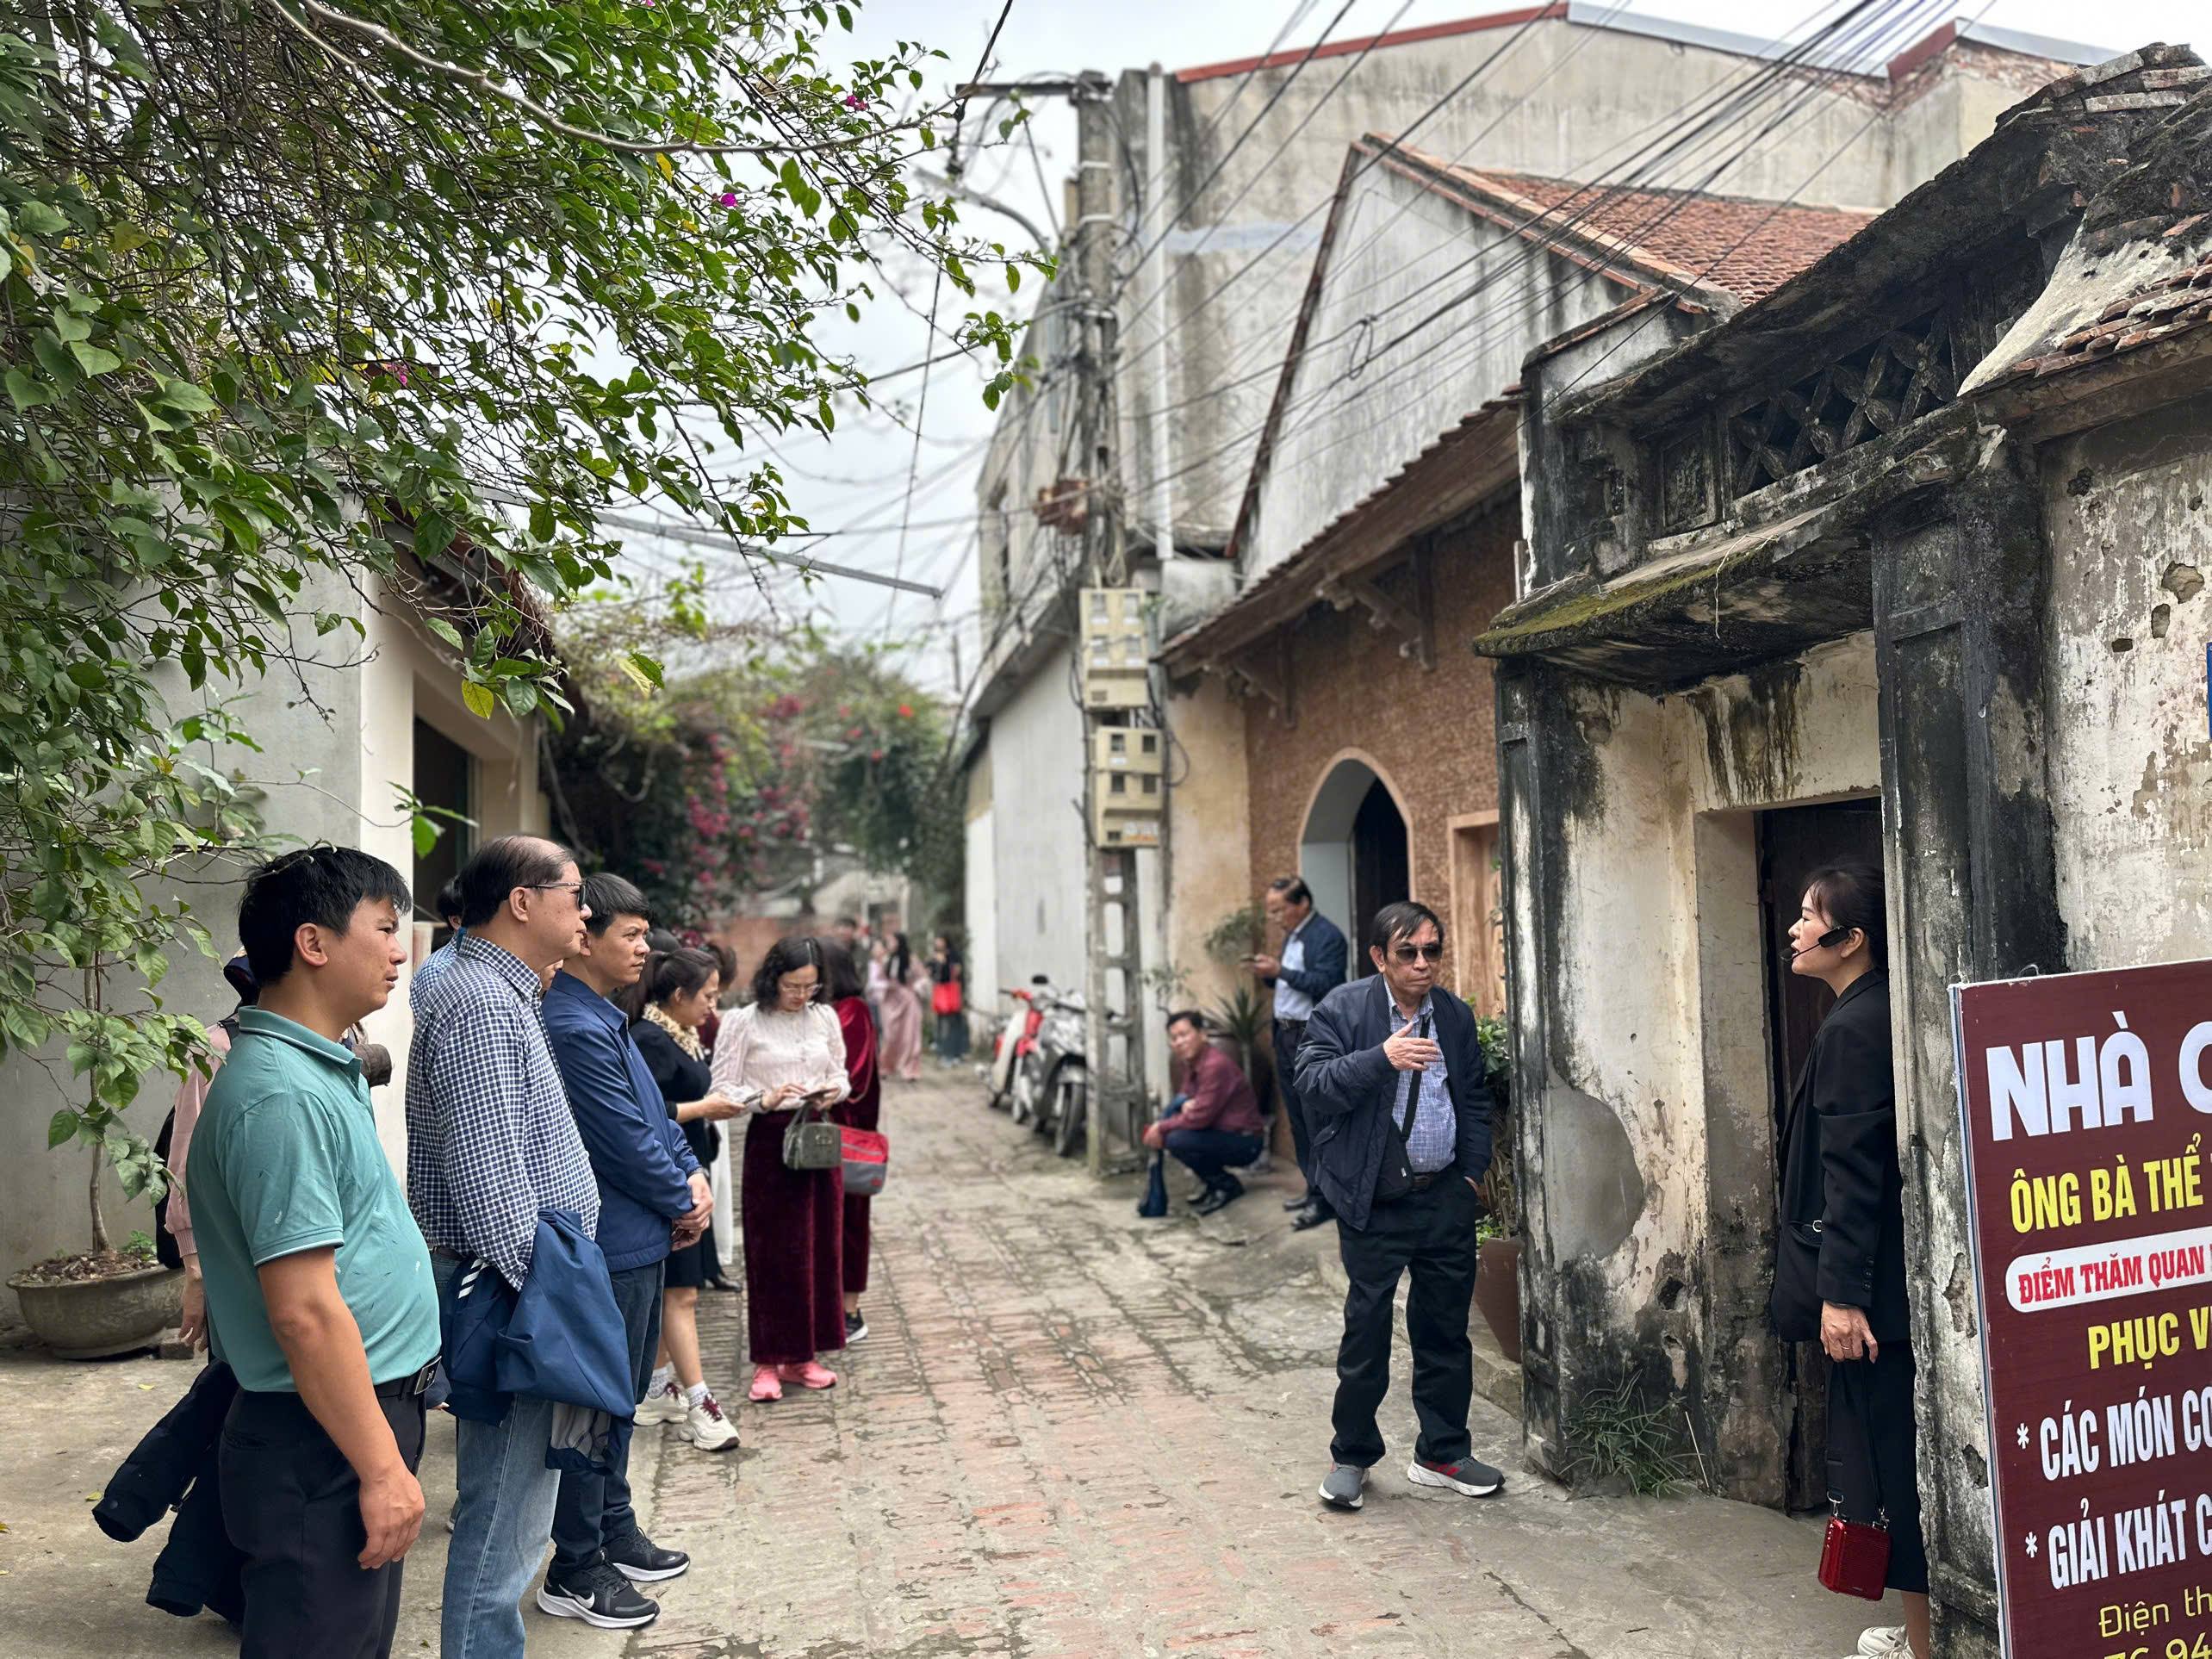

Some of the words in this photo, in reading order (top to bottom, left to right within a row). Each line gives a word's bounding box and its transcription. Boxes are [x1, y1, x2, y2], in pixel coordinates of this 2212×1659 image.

[1986, 1010, 2153, 1141] NHÀ
[2010, 1169, 2081, 1233] ÔNG
[2091, 1154, 2137, 1221] BÀ
[2143, 1133, 2203, 1212] THỂ
[2018, 1257, 2075, 1303] ĐIỂM
[2080, 1252, 2143, 1293] THĂM
[2148, 1246, 2205, 1288] QUAN
[2088, 1313, 2179, 1370] PHỤC
[2189, 1306, 2212, 1349] V
[2041, 1400, 2099, 1480] CÁC
[2107, 1386, 2175, 1467] MÓN
[2048, 1498, 2108, 1589] GIẢI
[2115, 1489, 2186, 1574] KHÁT
[2098, 1600, 2170, 1637] Điện
